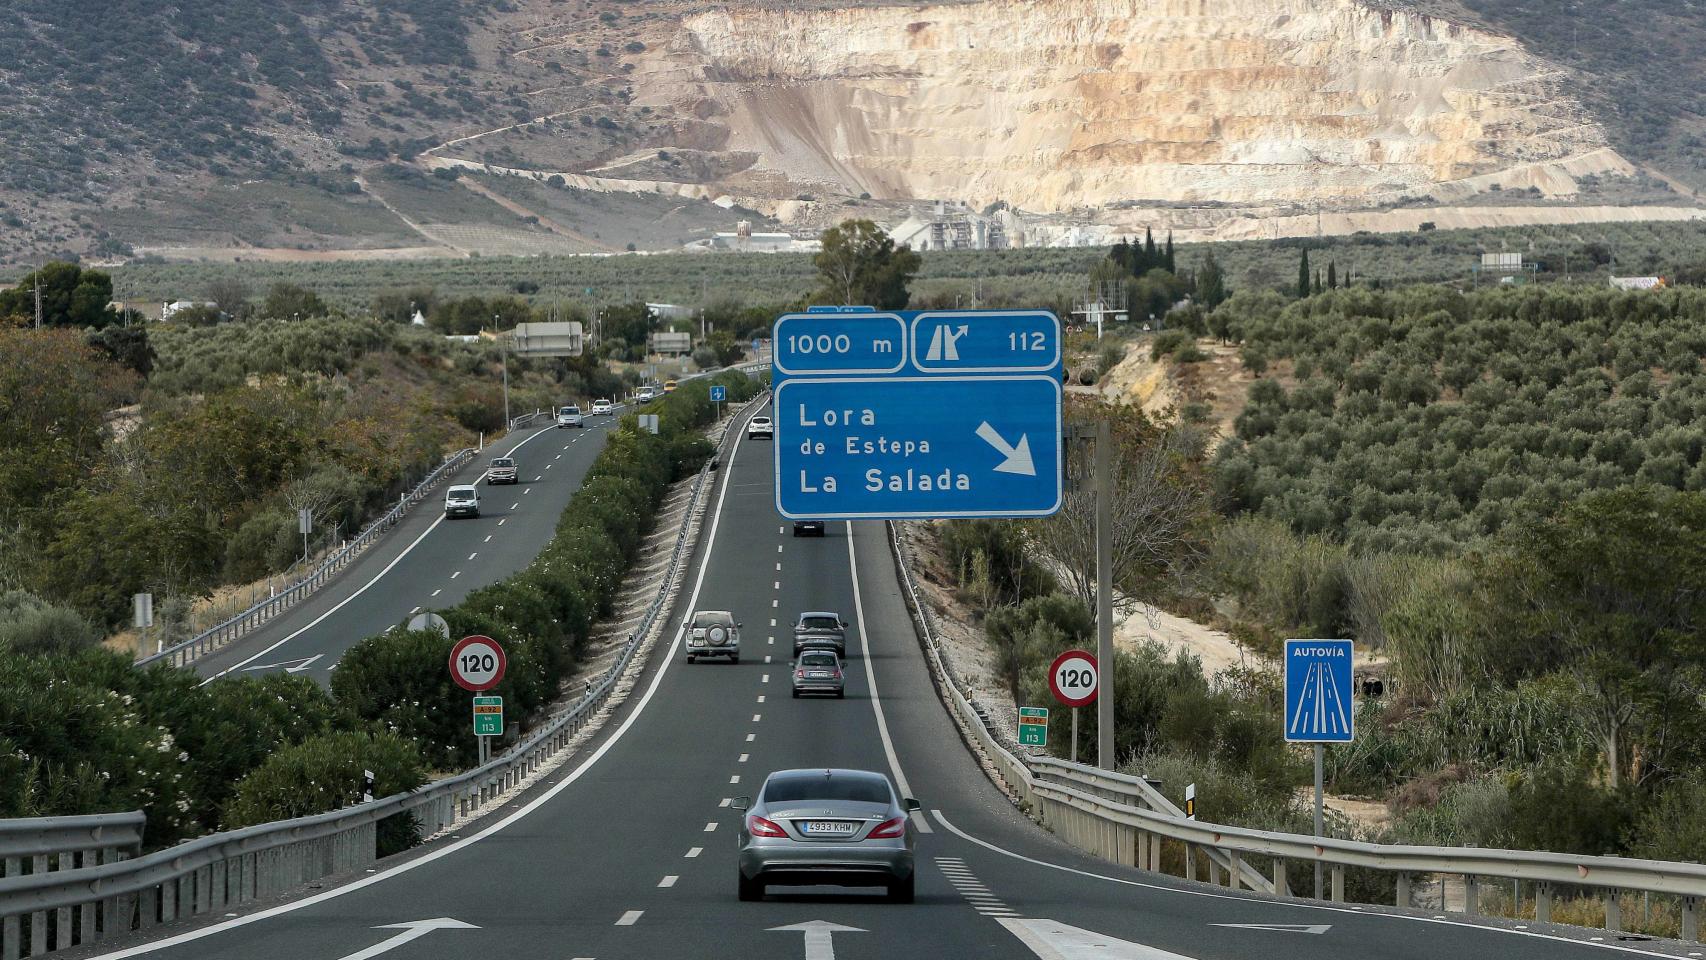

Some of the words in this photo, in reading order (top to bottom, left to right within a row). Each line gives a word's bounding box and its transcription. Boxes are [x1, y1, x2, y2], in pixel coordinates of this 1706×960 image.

[788, 335, 850, 354] 1000
[873, 339, 892, 353] m
[1009, 332, 1046, 351] 112
[799, 403, 876, 426] Lora
[800, 438, 826, 455] de
[846, 436, 930, 457] Estepa
[800, 469, 838, 493] La
[865, 468, 970, 492] Salada
[1293, 646, 1345, 657] AUTOVÍA
[461, 654, 494, 673] 120
[1060, 669, 1093, 688] 120
[482, 723, 494, 732] 113
[1026, 734, 1039, 743] 113
[809, 822, 832, 831] 4933
[834, 822, 851, 831] KHM
